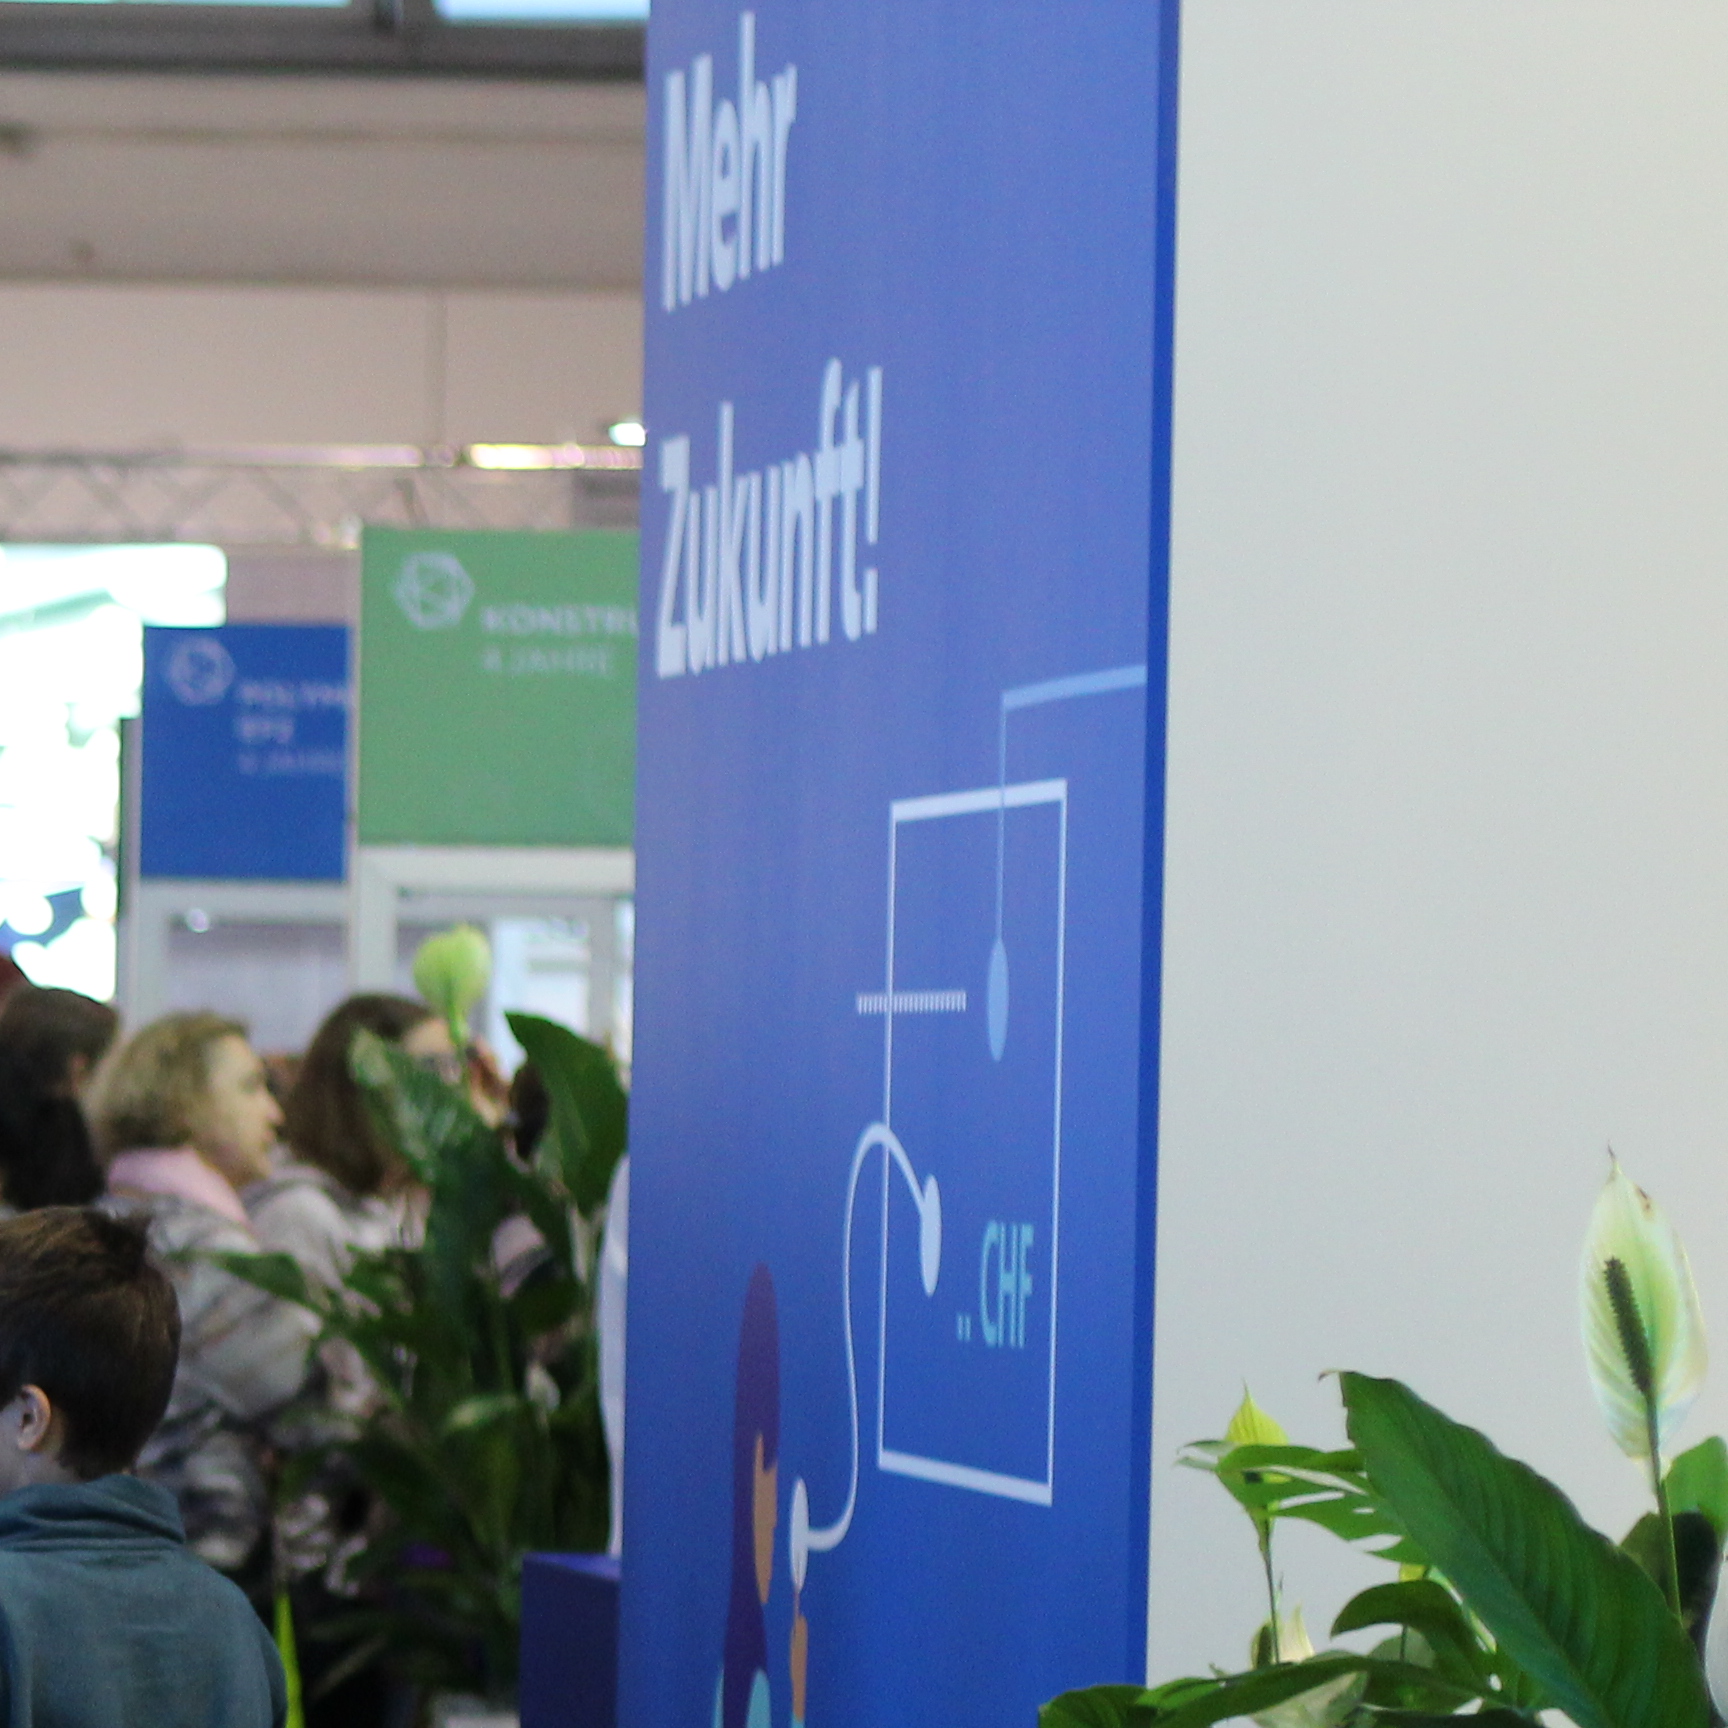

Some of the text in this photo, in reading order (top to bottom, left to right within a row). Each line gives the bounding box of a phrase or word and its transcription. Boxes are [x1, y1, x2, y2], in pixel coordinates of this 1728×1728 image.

[663, 12, 797, 311] Mehr
[656, 359, 882, 679] Zukunft!
[980, 1219, 1035, 1347] CHF
